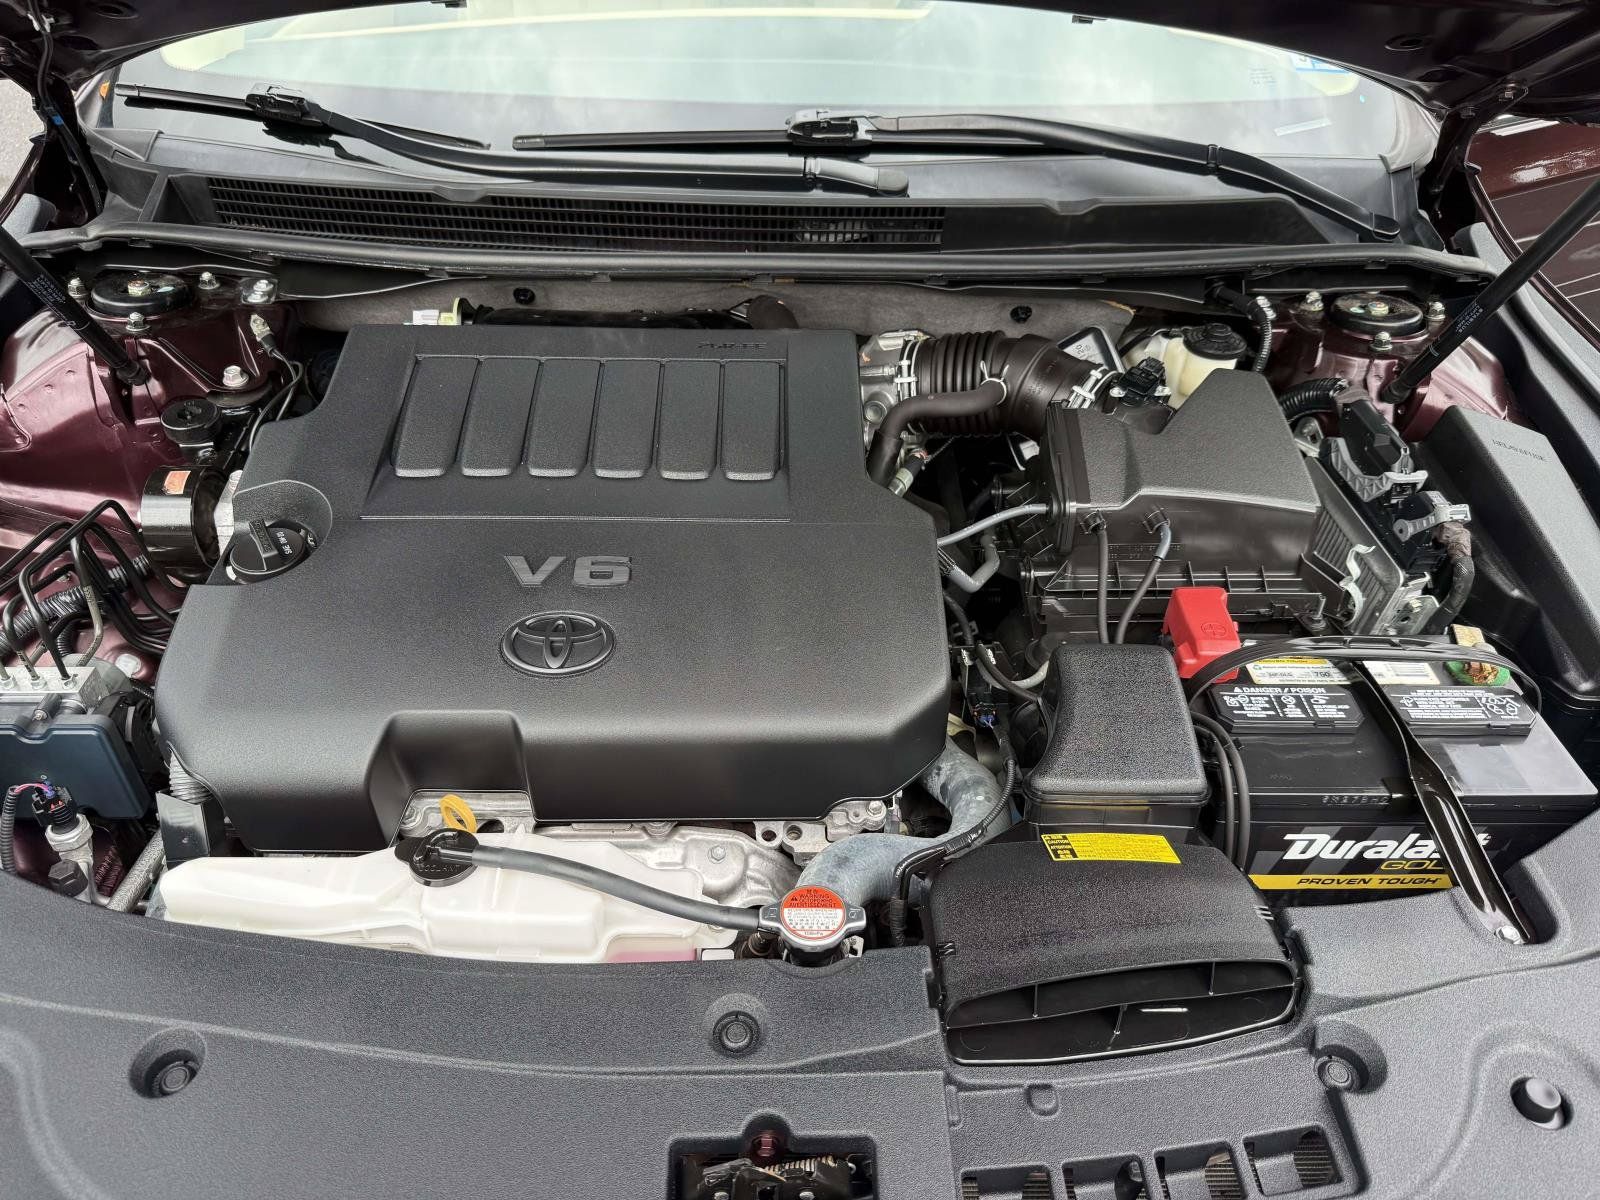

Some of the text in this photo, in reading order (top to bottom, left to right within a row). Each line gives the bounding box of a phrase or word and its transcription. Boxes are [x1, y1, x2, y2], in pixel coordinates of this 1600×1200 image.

[503, 555, 633, 588] V6
[1283, 833, 1492, 860] Durala
[1380, 860, 1444, 870] GOL
[1378, 877, 1440, 885] TOUGH
